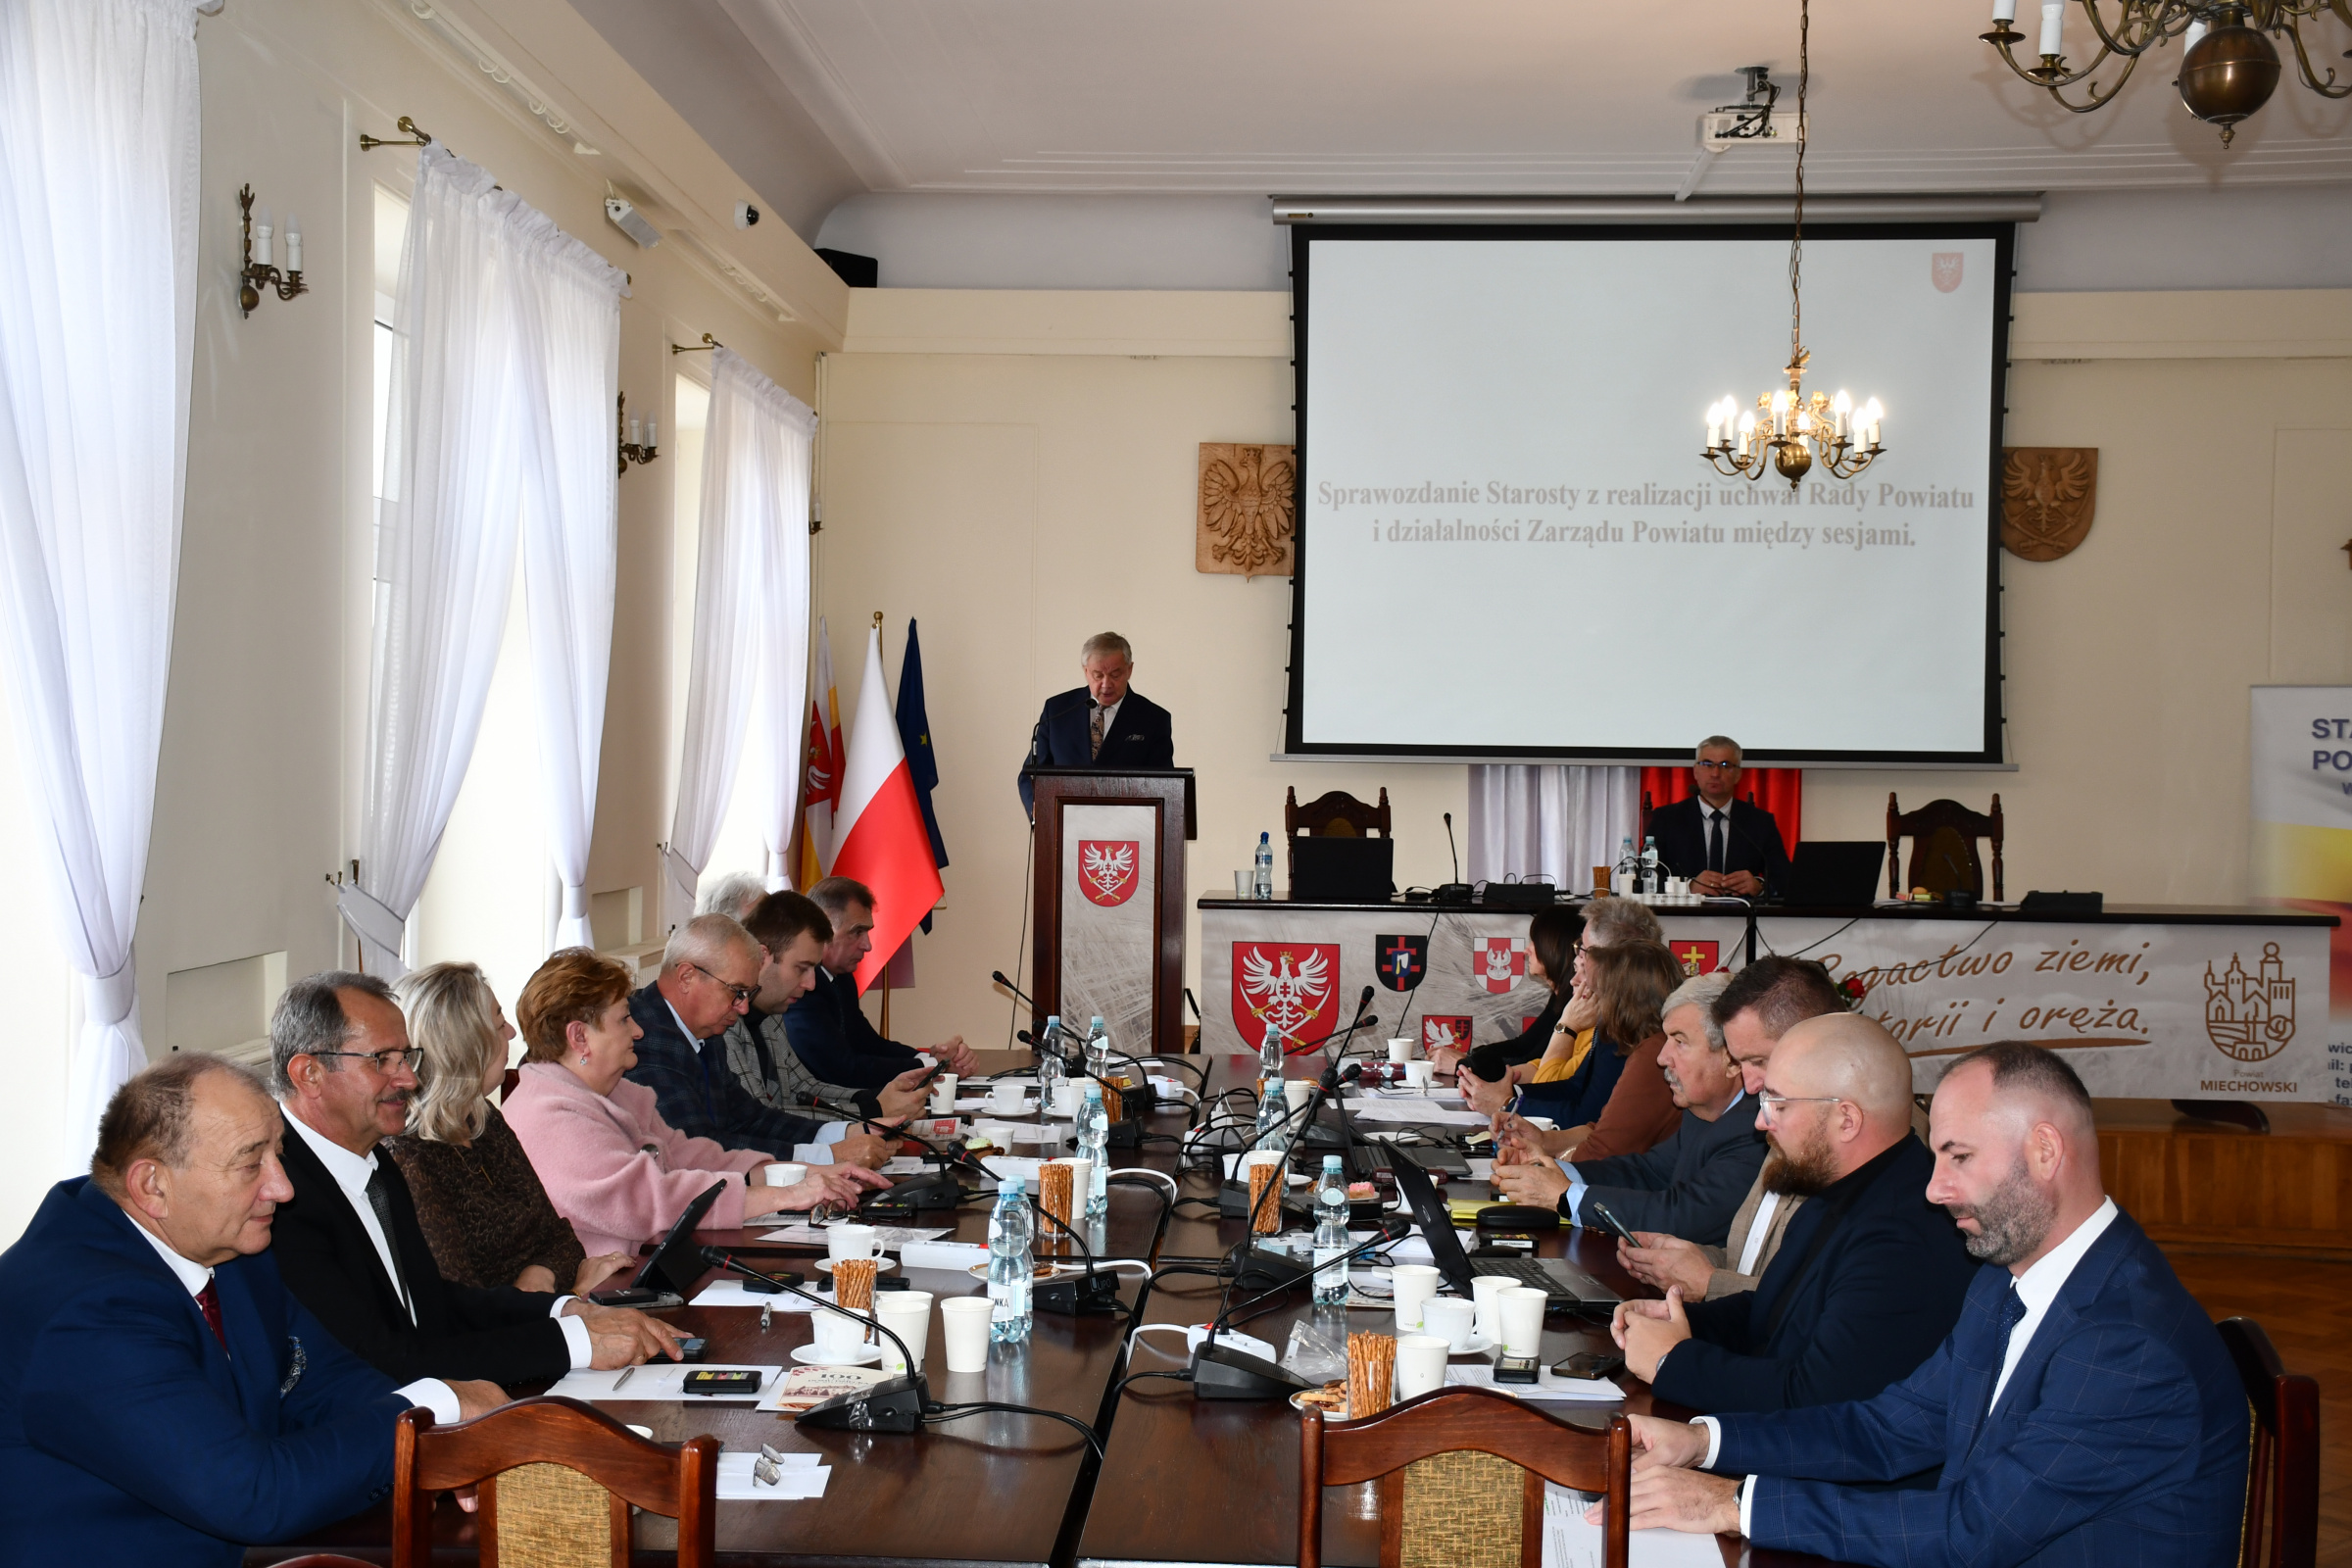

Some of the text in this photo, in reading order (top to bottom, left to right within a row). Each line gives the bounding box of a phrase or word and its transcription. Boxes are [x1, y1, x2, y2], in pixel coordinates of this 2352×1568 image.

[1318, 481, 1975, 512] Sprawozdanie Starosty z realizacji uchwał Rady Powiatu
[1373, 518, 1916, 551] i działalności Zarządu Powiatu między sesjami.
[2312, 718, 2352, 739] ST
[2034, 939, 2150, 986] ziemi,
[1982, 998, 2005, 1033] i
[2020, 999, 2148, 1034] oręża.
[2233, 1069, 2264, 1078] Powiat
[2335, 1077, 2352, 1089] te
[2200, 1080, 2298, 1093] MIECHOWSKI
[992, 1298, 1009, 1308] NKA
